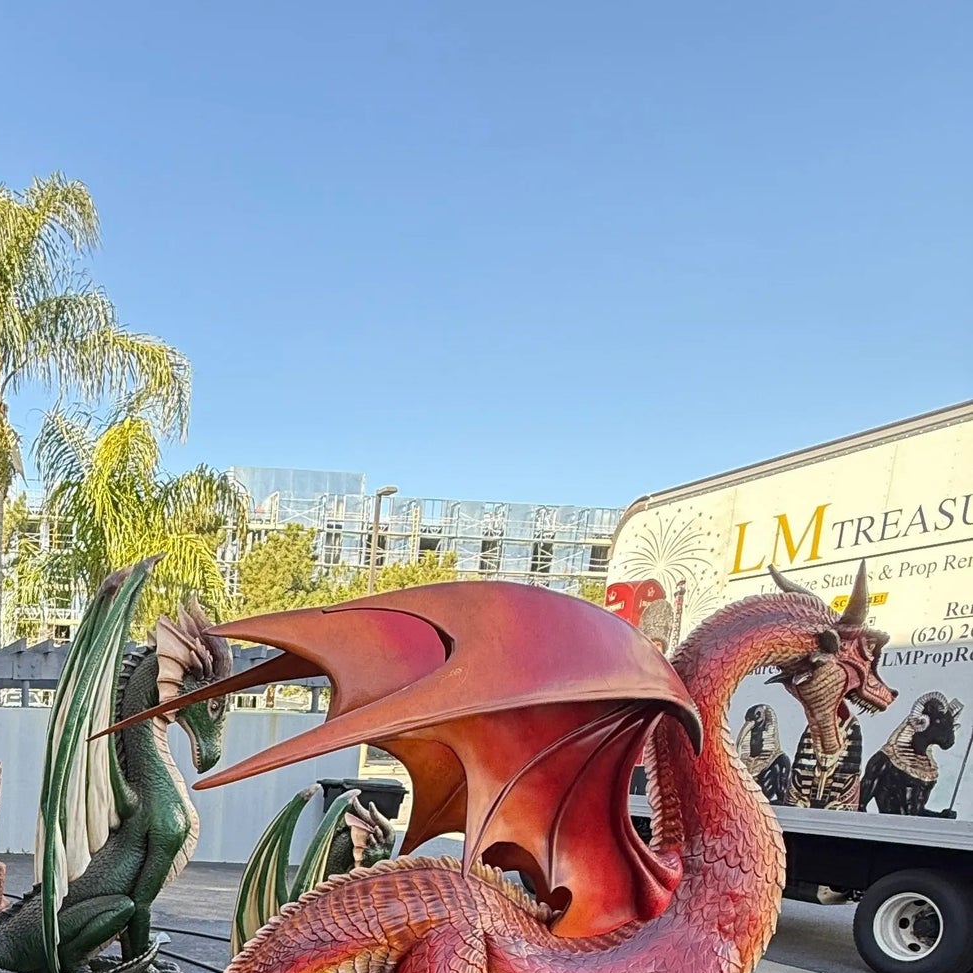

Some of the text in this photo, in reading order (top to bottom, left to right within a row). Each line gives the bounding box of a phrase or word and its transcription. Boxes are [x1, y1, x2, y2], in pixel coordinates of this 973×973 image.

[727, 502, 832, 575] LM
[878, 565, 894, 581] &
[898, 561, 938, 579] Prop
[946, 601, 973, 617] Re
[910, 624, 954, 648] (626)
